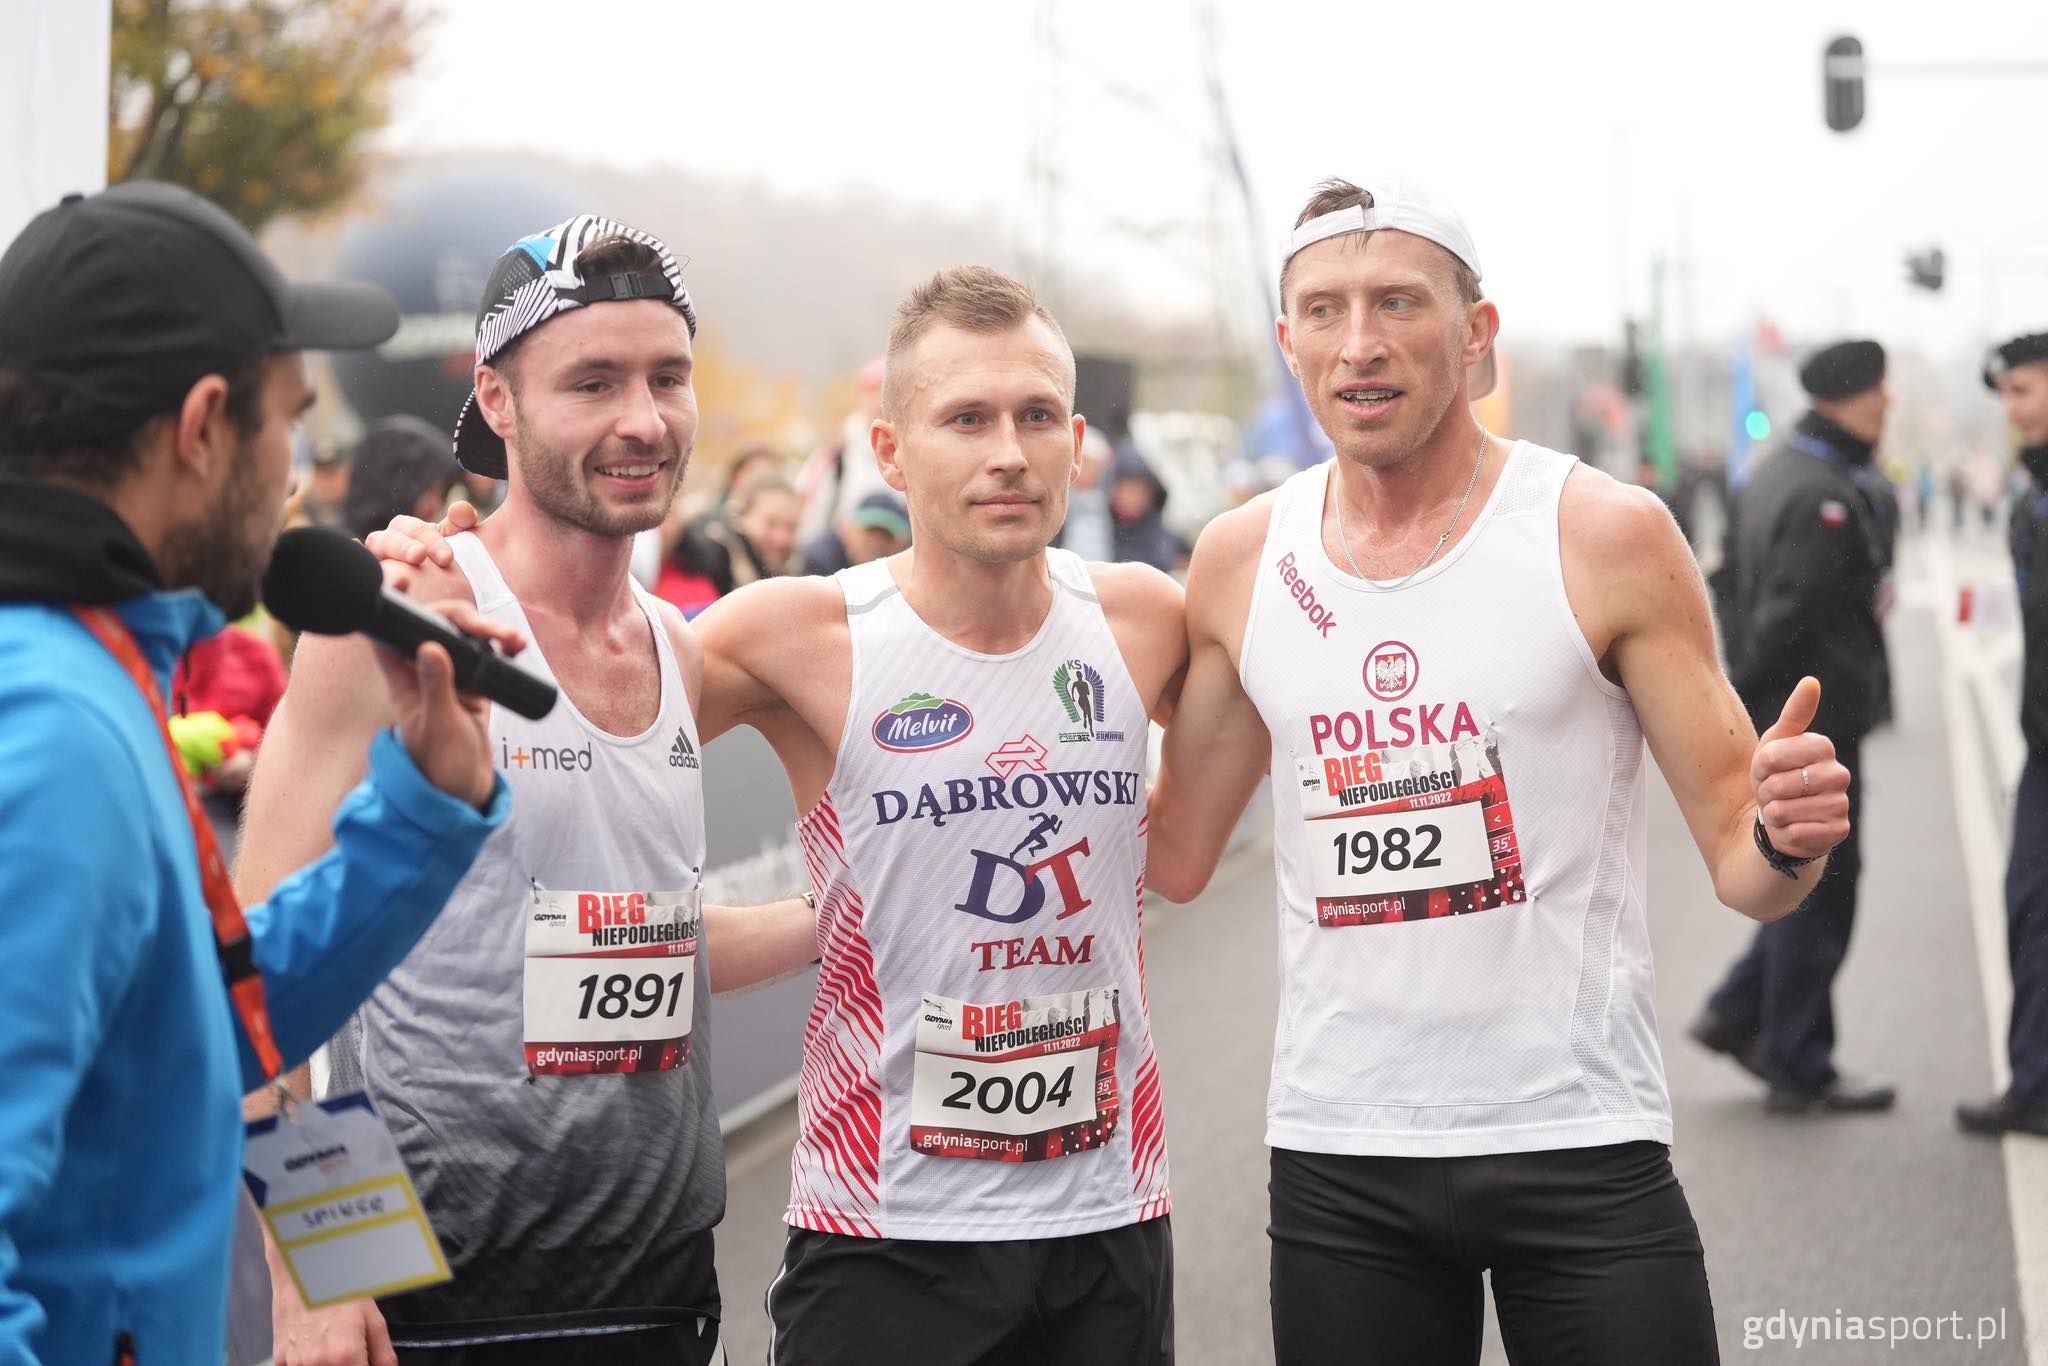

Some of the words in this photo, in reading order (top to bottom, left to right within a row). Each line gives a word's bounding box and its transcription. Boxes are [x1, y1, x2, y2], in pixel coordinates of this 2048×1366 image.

[1276, 551, 1337, 639] Reebok
[1067, 659, 1082, 670] KS
[887, 713, 958, 741] Melvit
[1310, 702, 1480, 755] POLSKA
[502, 736, 593, 773] i+med
[669, 753, 700, 770] adidas
[1324, 752, 1384, 797] BIEG
[1338, 770, 1459, 807] NIEPODLEGŁOŚCI
[872, 770, 1139, 828] DĄBROWSKI
[1409, 792, 1453, 809] 11.11.2022
[1333, 824, 1443, 876] 1982
[1492, 835, 1512, 852] 35'
[954, 836, 1093, 925] DT
[578, 892, 647, 935] BIEG
[1322, 896, 1407, 921] gdyniasport.pl
[970, 934, 1096, 972] TEAM
[578, 972, 684, 1020] 1891
[924, 1014, 953, 1026] GDYNIA
[962, 1001, 1023, 1041] BIEG
[975, 1016, 1088, 1053] NIEPODLEGŁOŚCI
[536, 1046, 642, 1067] gdyniasport.pl
[1043, 1037, 1081, 1054] 11.11.2022
[942, 1066, 1075, 1115] 2004
[1097, 1079, 1113, 1094] 35'
[923, 1133, 1028, 1156] gdyniasport.pl
